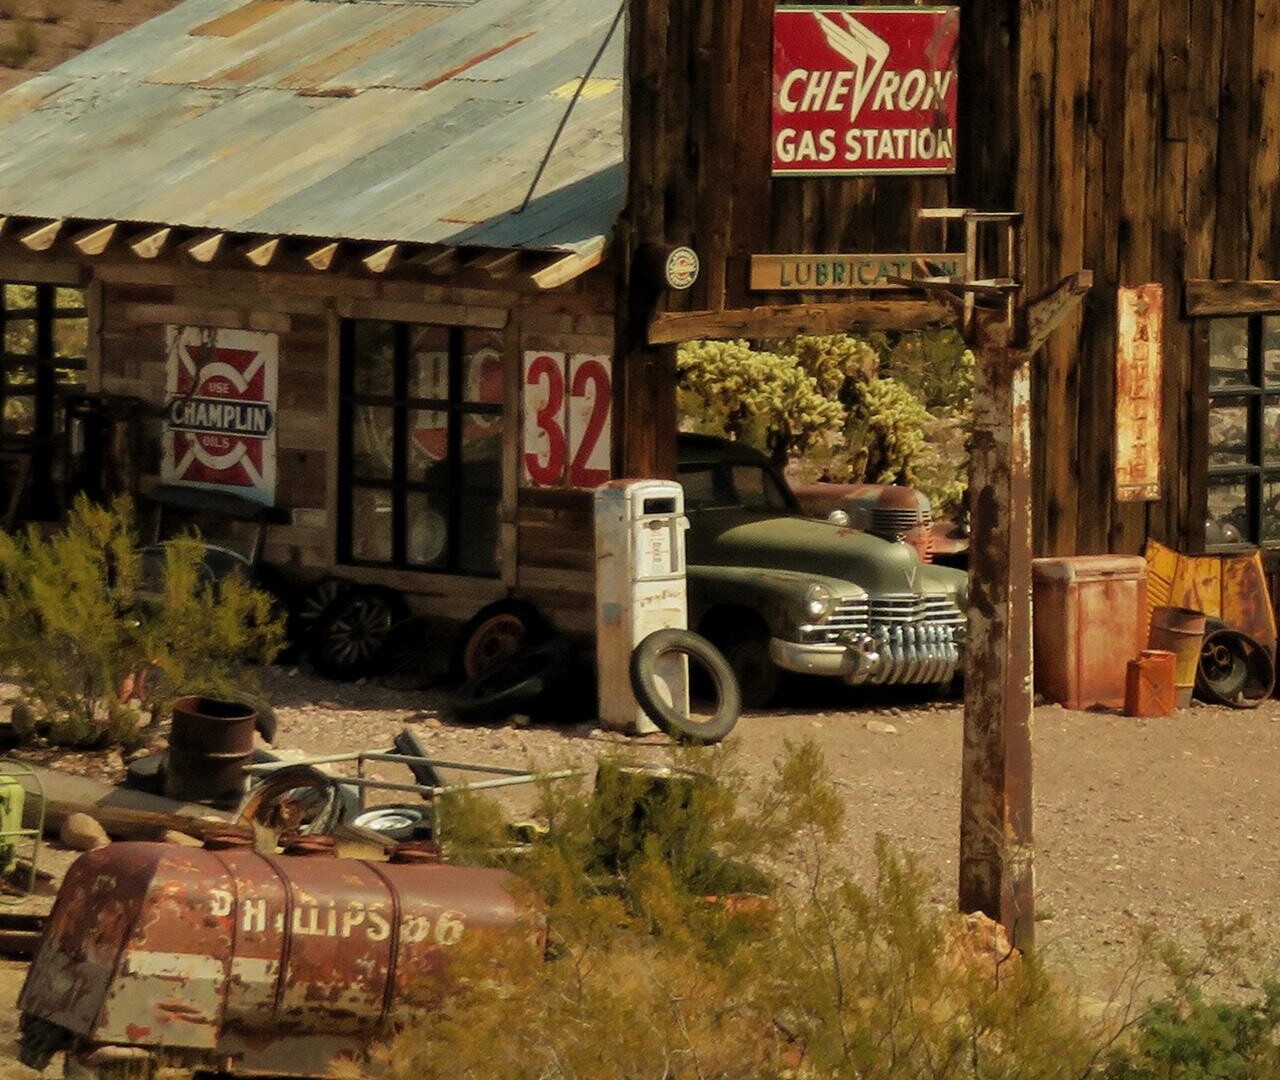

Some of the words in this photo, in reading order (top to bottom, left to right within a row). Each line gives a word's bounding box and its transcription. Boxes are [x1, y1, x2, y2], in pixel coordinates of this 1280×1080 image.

[779, 63, 953, 123] CHEVRON
[775, 128, 836, 163] GAS
[844, 128, 953, 162] STATION
[208, 380, 231, 395] USE
[171, 399, 266, 432] CHAMPLIN
[524, 355, 612, 488] 32
[202, 435, 231, 449] OILS
